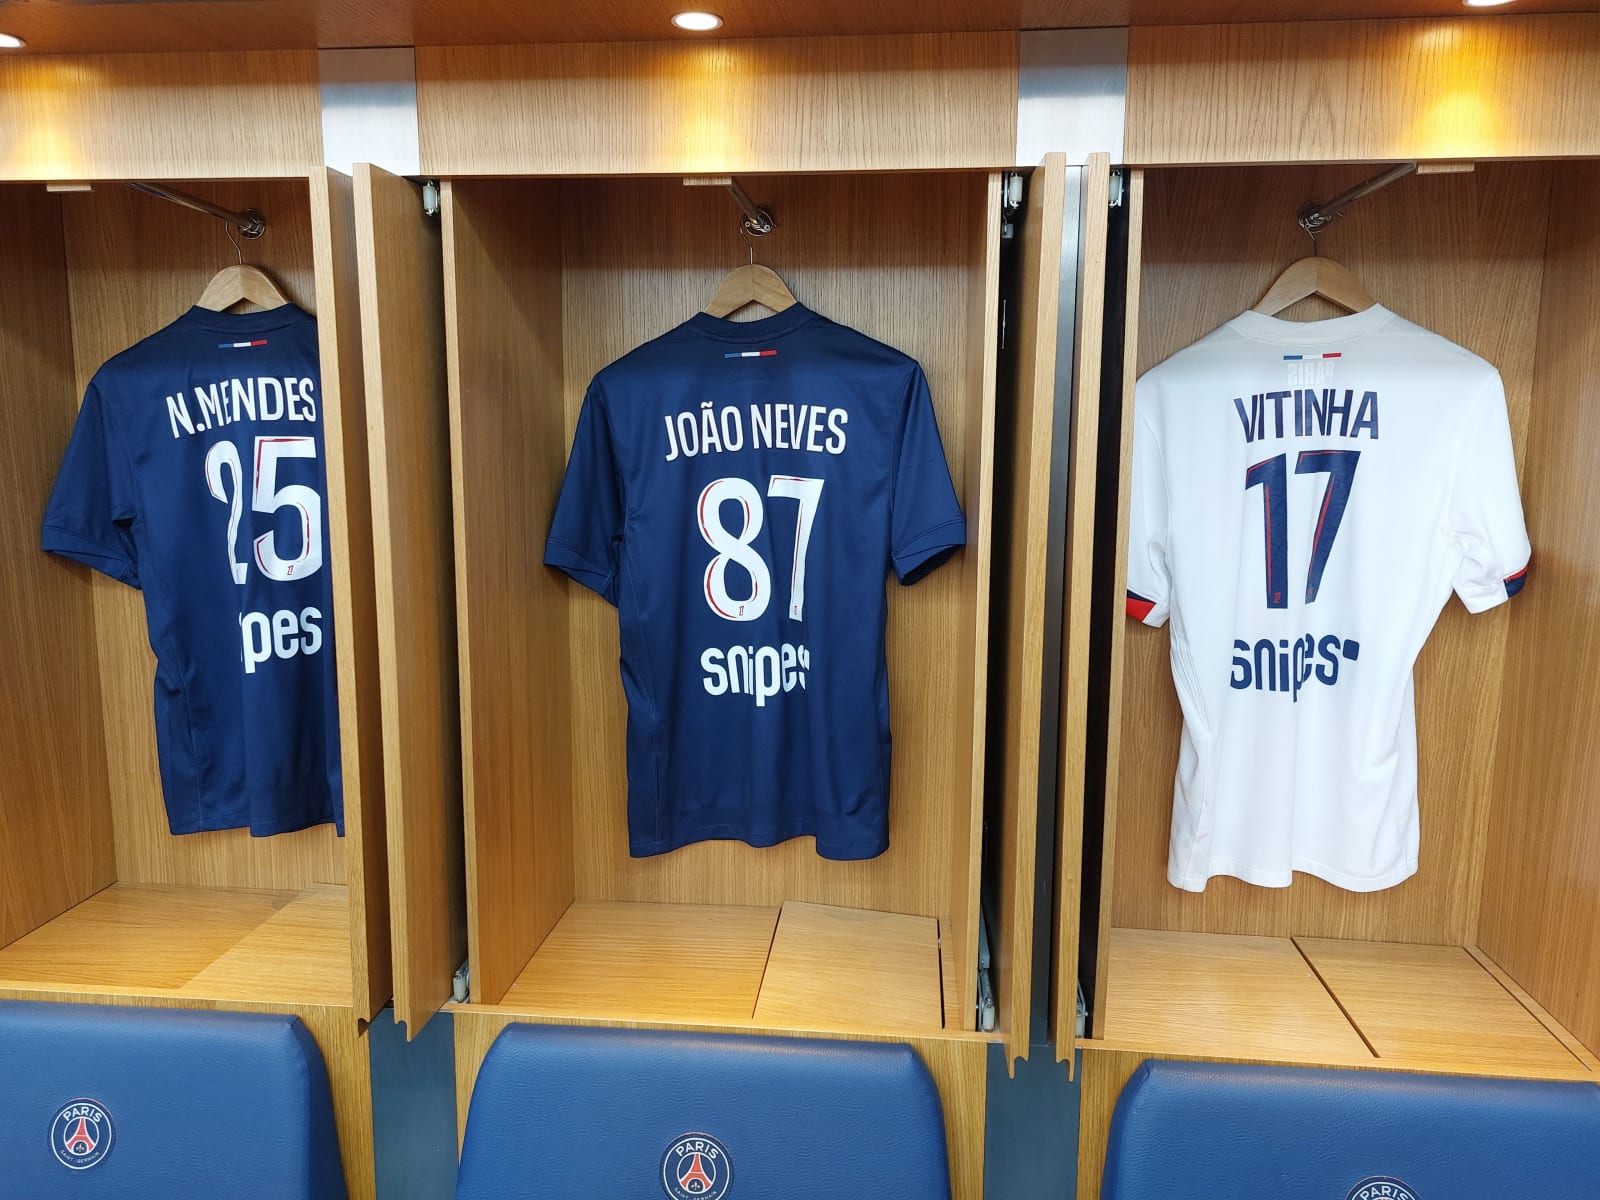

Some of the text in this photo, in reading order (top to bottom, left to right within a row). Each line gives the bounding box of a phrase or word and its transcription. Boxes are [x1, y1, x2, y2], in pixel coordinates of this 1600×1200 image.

[664, 401, 849, 461] JOÃO NEVES
[1233, 388, 1379, 443] VITINHA
[205, 435, 323, 585] 25
[1245, 449, 1361, 609] 17
[697, 474, 825, 622] 87
[63, 1106, 103, 1122] PARIS
[675, 1141, 719, 1159] PARIS
[1359, 1185, 1409, 1200] PARIS
